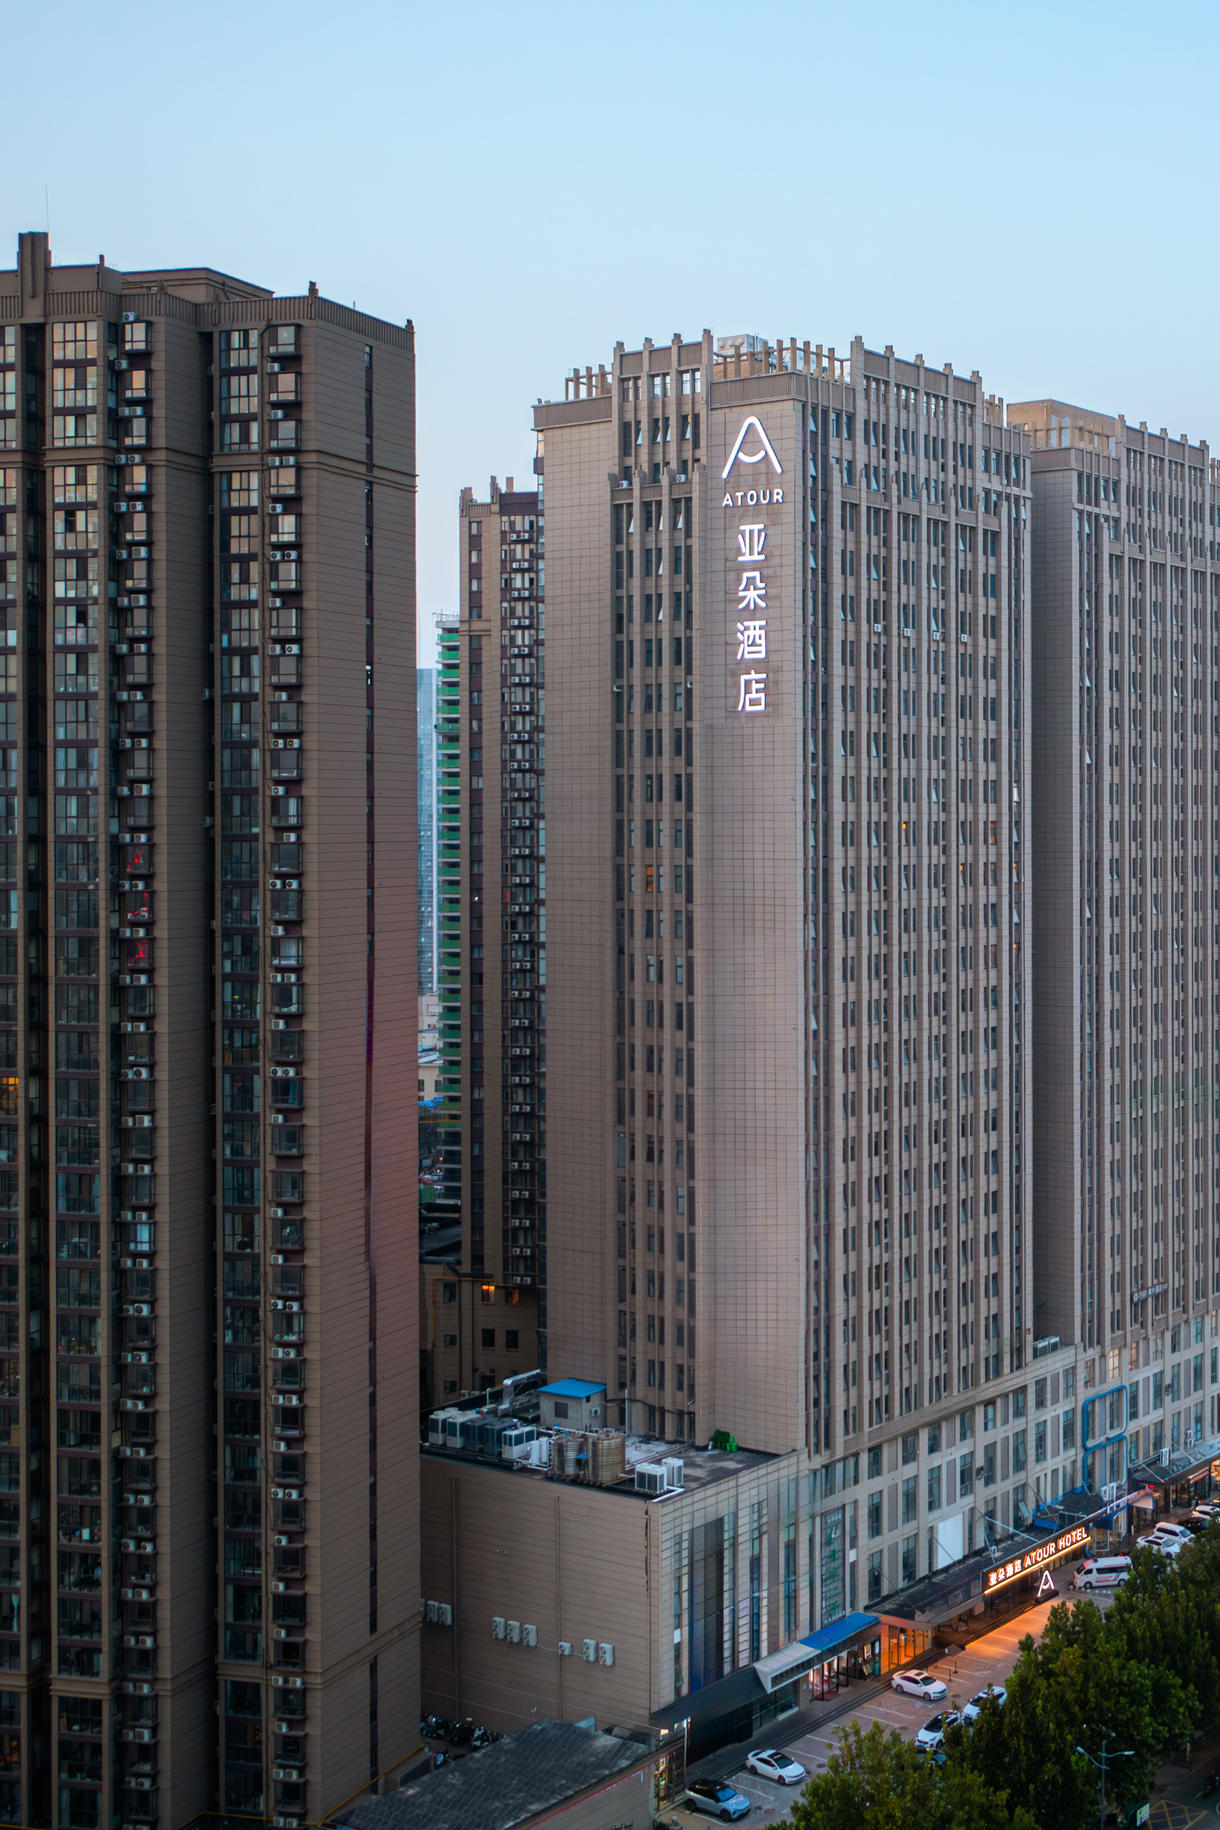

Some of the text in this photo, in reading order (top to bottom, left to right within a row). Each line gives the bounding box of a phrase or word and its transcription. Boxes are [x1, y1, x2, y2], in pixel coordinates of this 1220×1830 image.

[722, 488, 785, 507] ATOUR
[736, 523, 768, 713] 亚朵酒店
[988, 1527, 1088, 1586] 亚朵酒店 ATOUR HOTEL
